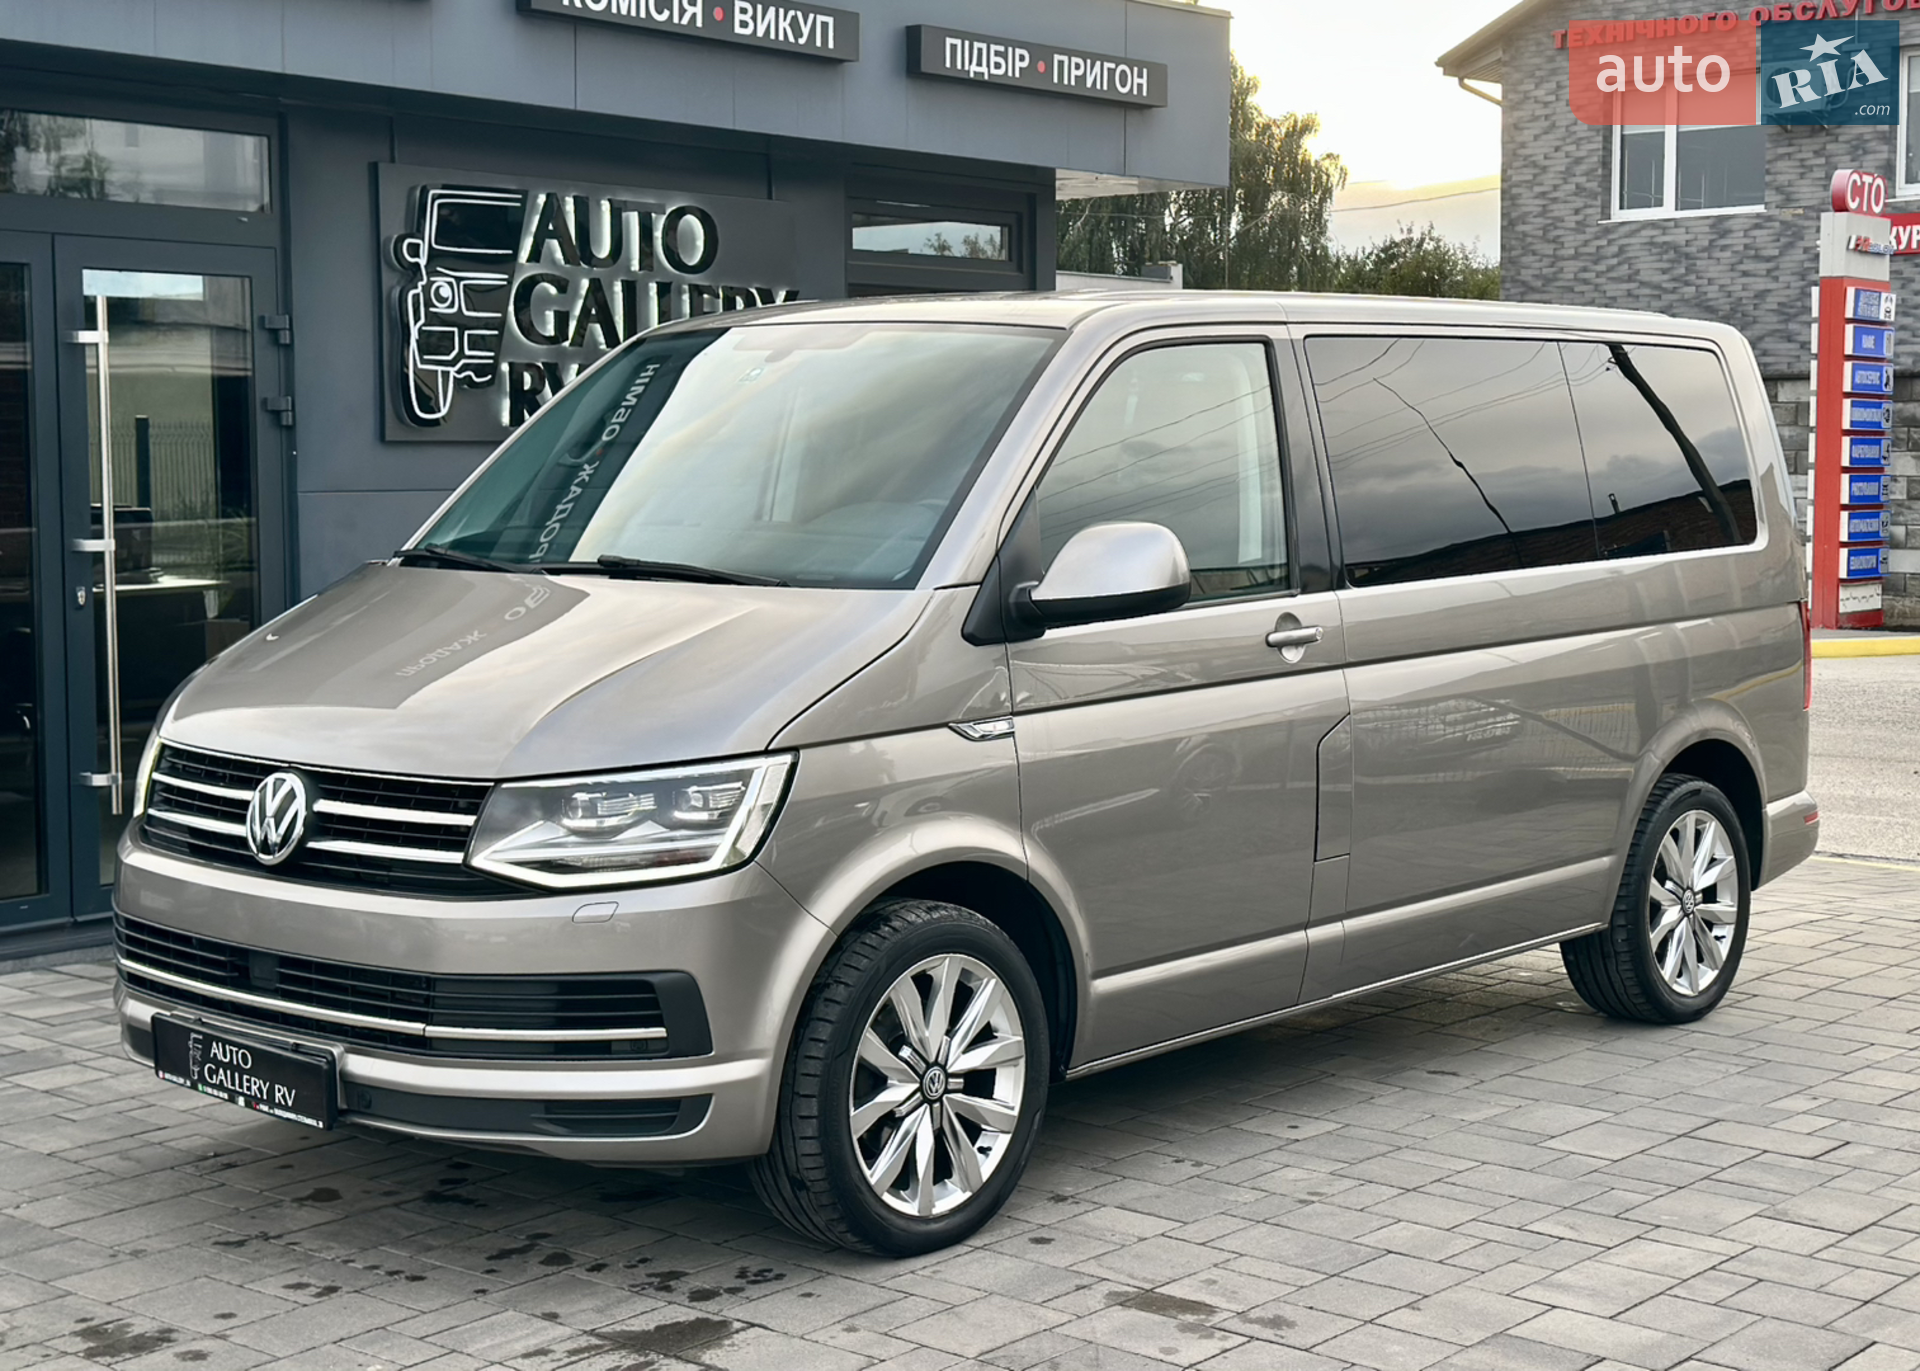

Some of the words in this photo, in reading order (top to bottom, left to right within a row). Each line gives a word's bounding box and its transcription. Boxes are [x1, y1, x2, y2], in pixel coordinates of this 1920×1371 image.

[734, 0, 835, 49] ВИКУП
[1552, 10, 1738, 49] ТЕХНІЧНОГО
[945, 37, 1030, 80] ПІДБІР
[1053, 54, 1148, 96] ПРИГОН
[522, 192, 719, 275] AUTO
[210, 1041, 252, 1069] AUTO
[204, 1063, 270, 1100] GALLERY
[274, 1084, 296, 1107] RV
